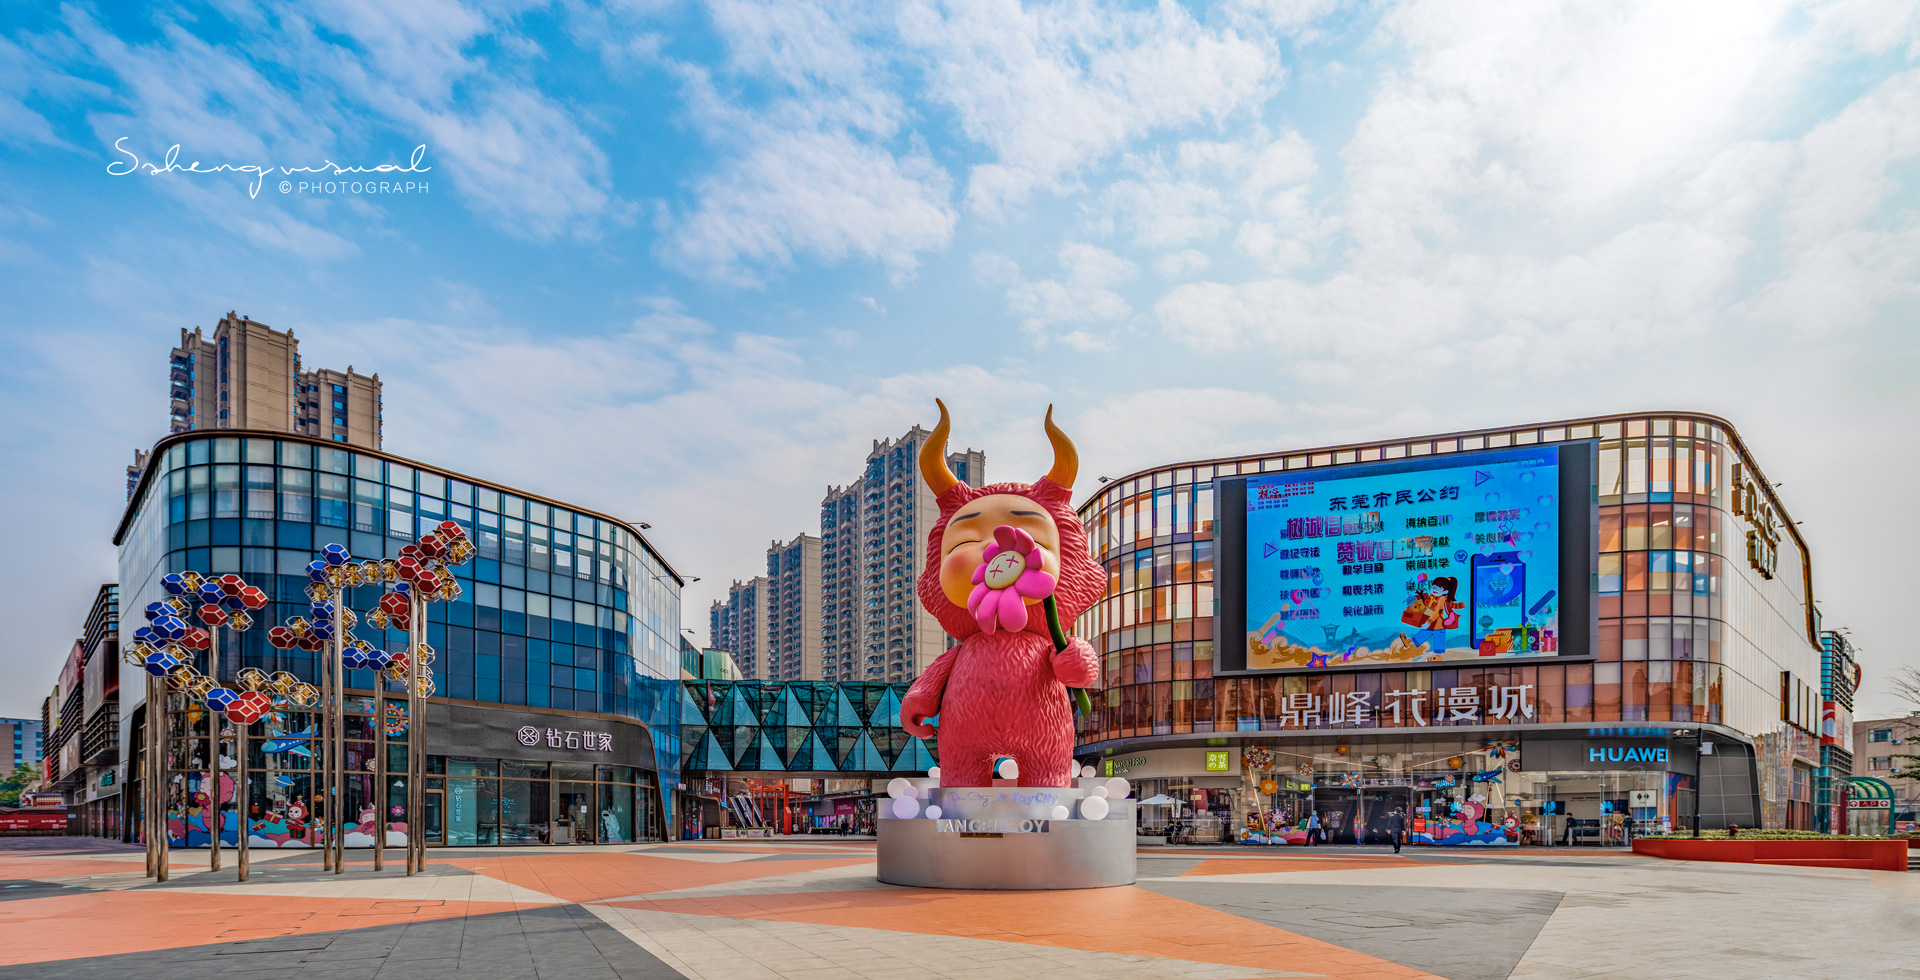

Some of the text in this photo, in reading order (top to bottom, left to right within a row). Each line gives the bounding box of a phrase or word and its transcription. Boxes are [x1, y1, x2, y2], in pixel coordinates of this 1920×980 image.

[1329, 485, 1460, 511] 东莞市民公约
[545, 727, 613, 753] 钻石世家
[1589, 747, 1669, 763] HUAWEI
